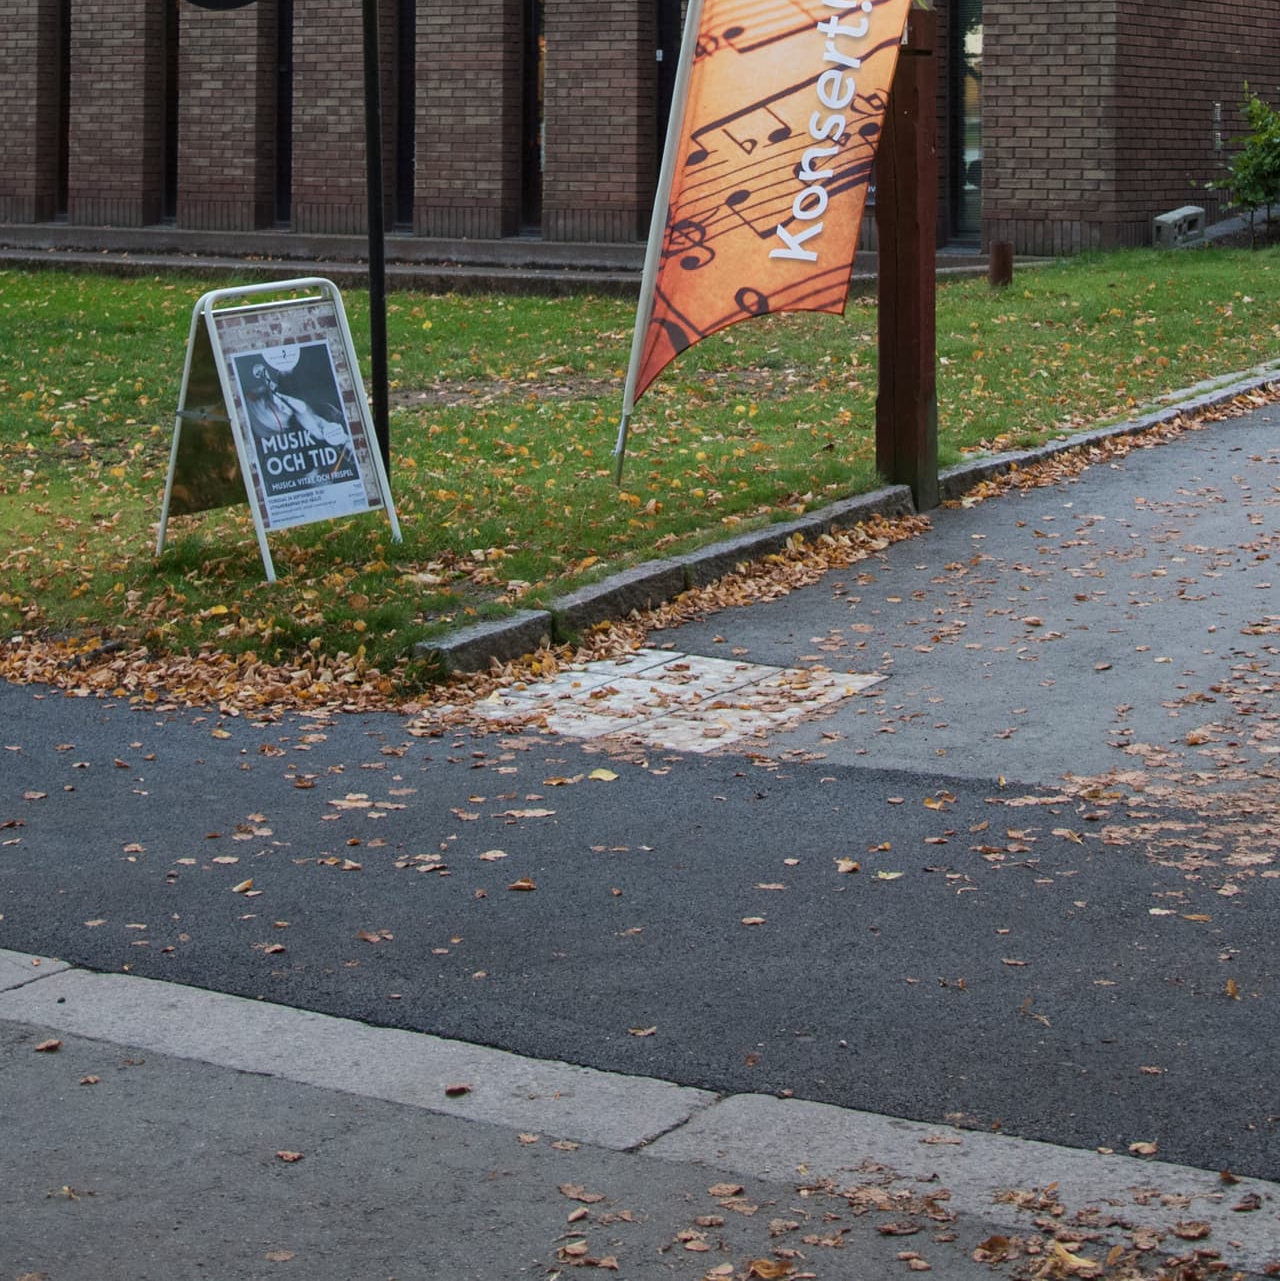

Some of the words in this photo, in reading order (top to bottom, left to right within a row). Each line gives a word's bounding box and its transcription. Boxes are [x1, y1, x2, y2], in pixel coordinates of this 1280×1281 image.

[261, 429, 317, 455] MUSIK
[266, 452, 306, 476] OCH
[308, 446, 338, 468] TID
